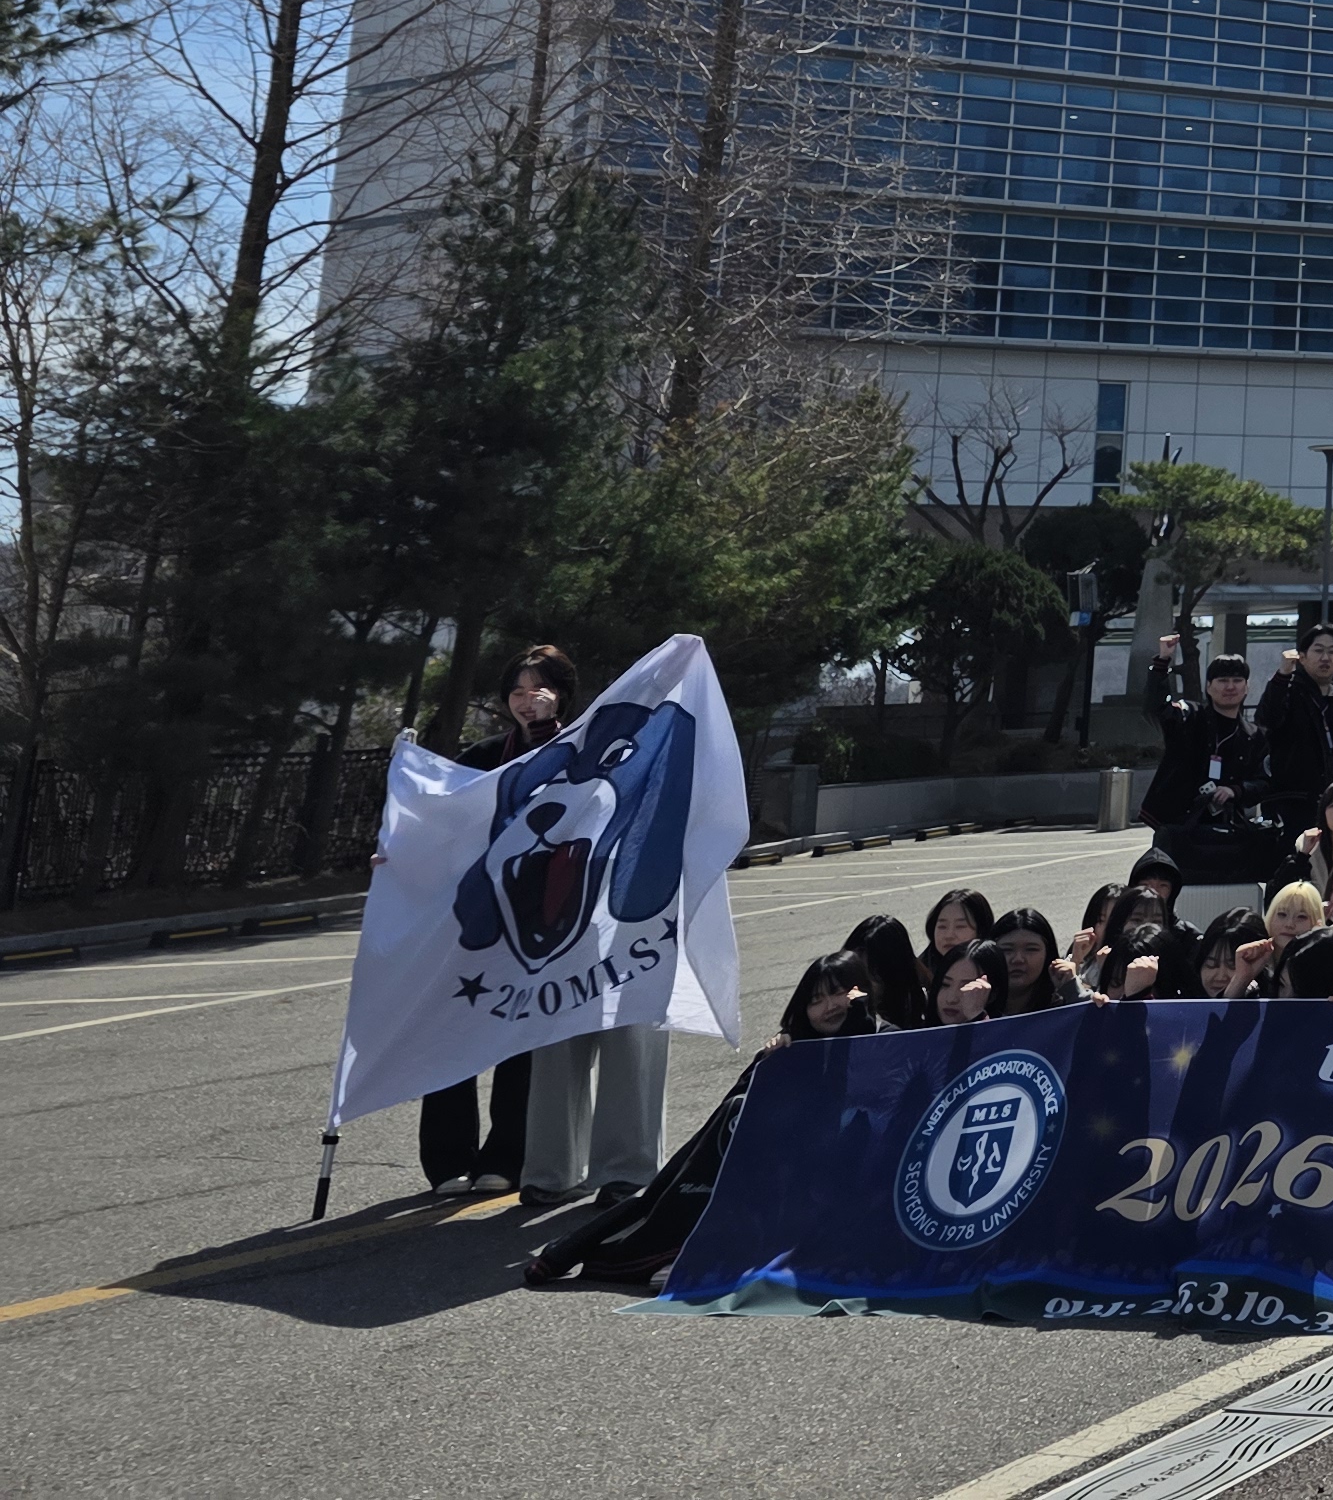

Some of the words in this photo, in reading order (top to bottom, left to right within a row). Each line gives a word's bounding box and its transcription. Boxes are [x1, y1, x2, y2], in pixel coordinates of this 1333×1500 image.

[922, 1082, 968, 1136] MEDICAL
[967, 1060, 1038, 1088] LABORATORY
[1033, 1070, 1059, 1117] SCIENCE
[904, 1161, 939, 1237] SEOYEONG
[939, 1224, 975, 1242] 1978
[981, 1143, 1052, 1233] UNIVERSITY
